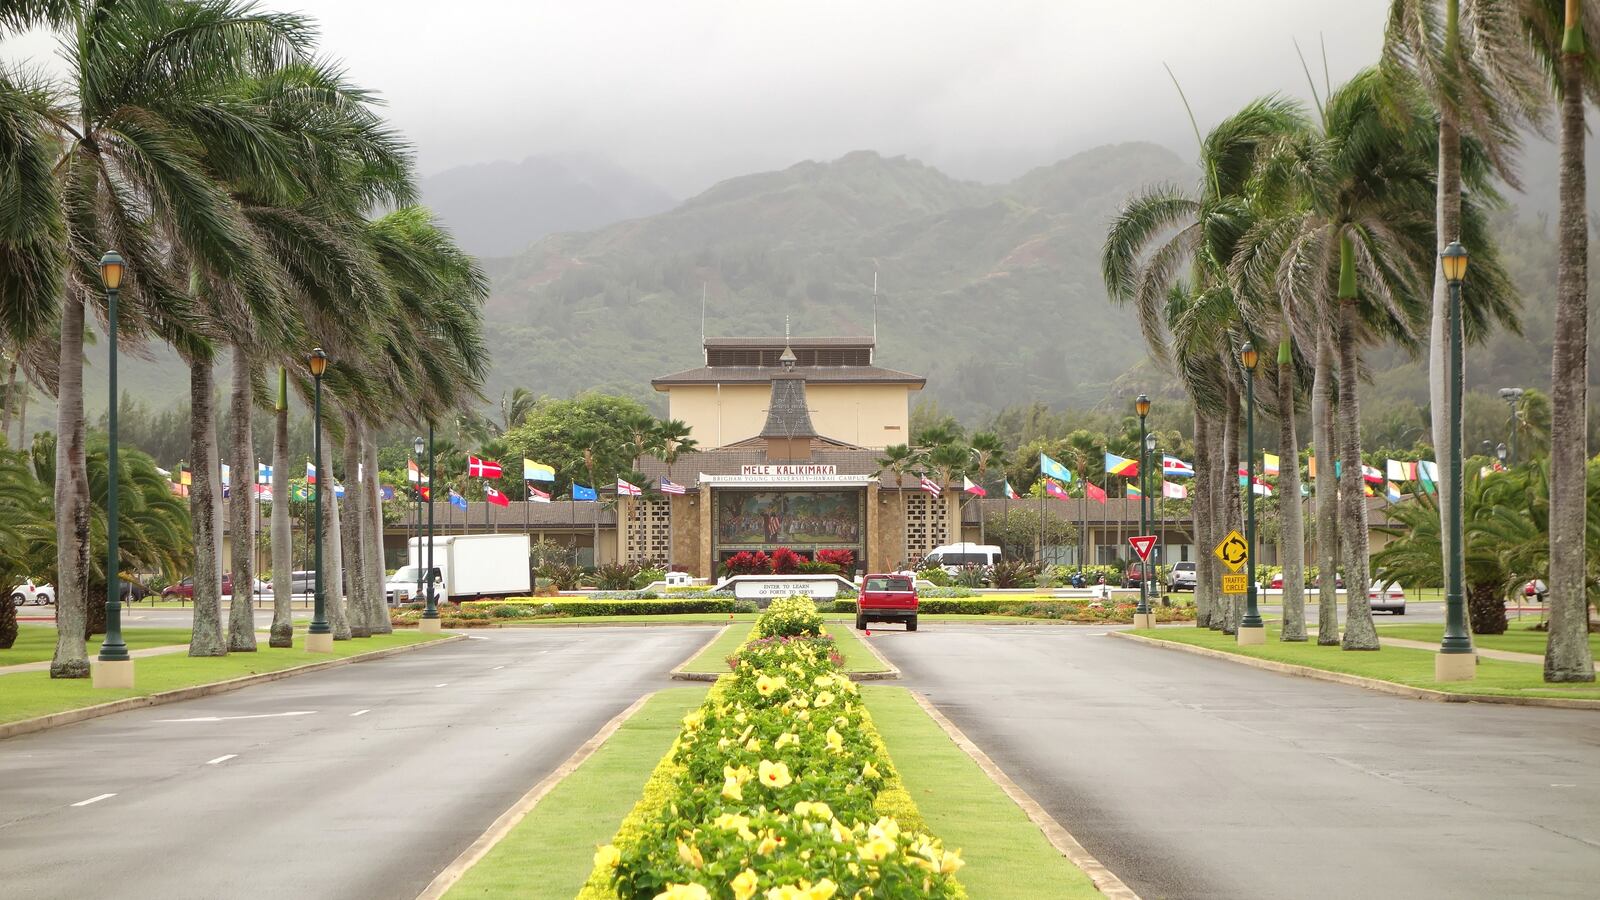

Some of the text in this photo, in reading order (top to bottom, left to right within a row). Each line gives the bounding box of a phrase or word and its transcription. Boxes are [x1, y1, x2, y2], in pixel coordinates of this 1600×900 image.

[744, 466, 834, 475] MELE KALIKIMAKA
[1224, 576, 1245, 584] TRAFFIC
